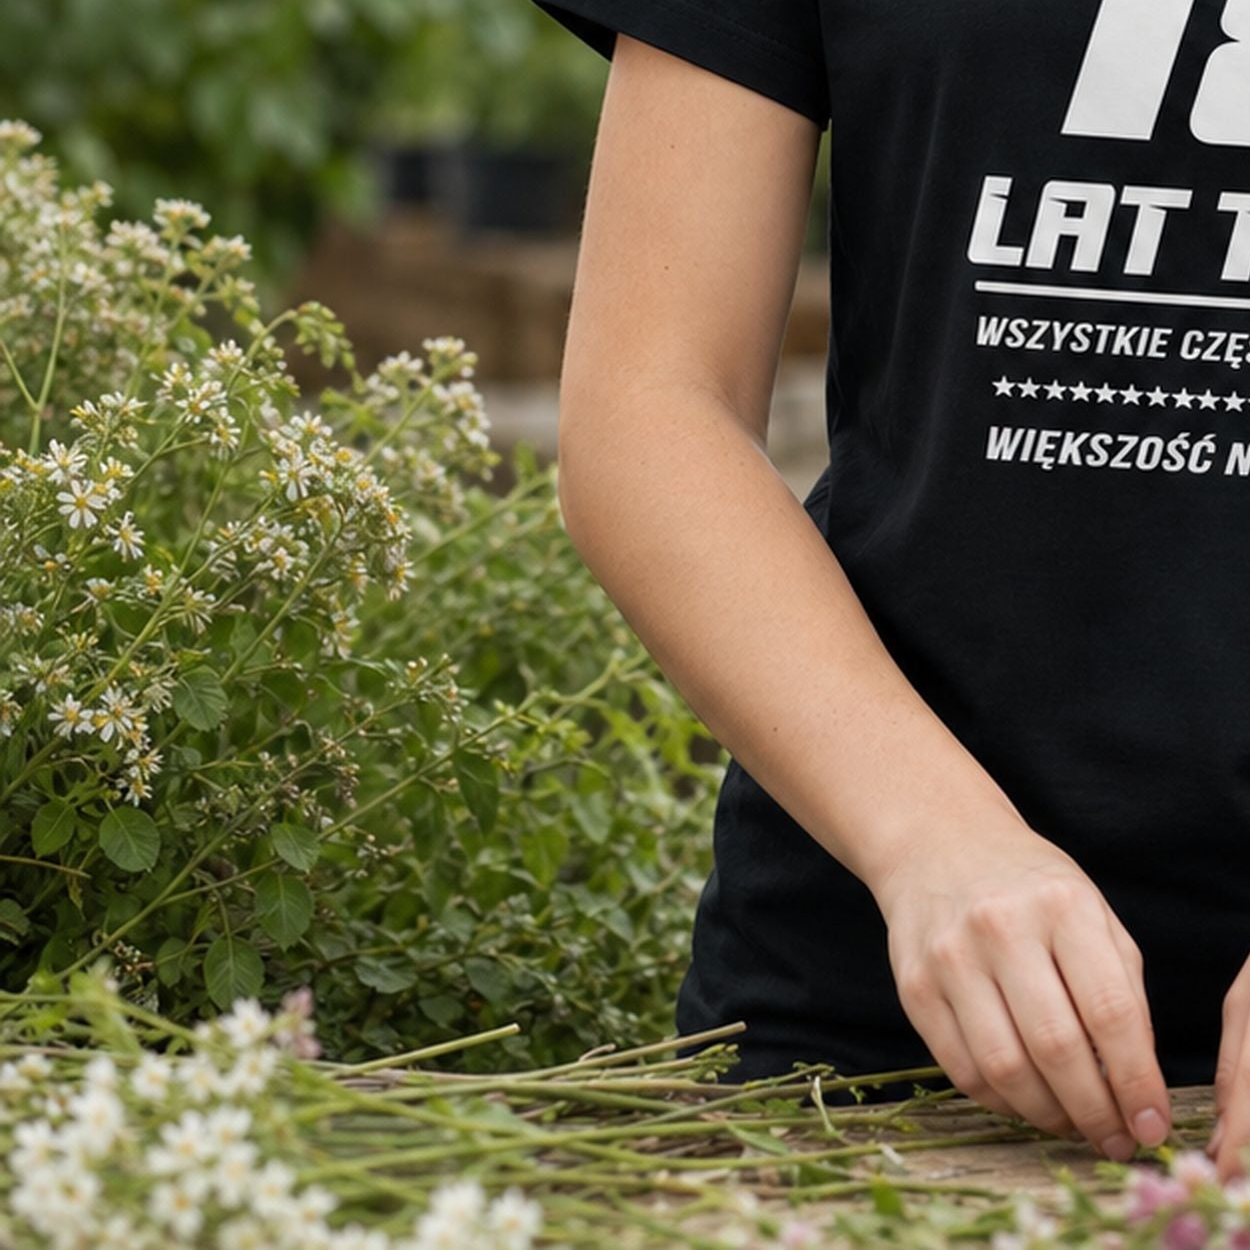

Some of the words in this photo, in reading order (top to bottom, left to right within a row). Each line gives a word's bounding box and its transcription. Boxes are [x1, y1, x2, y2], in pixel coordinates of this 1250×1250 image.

[968, 176, 1192, 275] LAT
[977, 316, 1172, 358] WSZYSTKIE
[987, 427, 1215, 473] WIĘKSZOŚĆ
